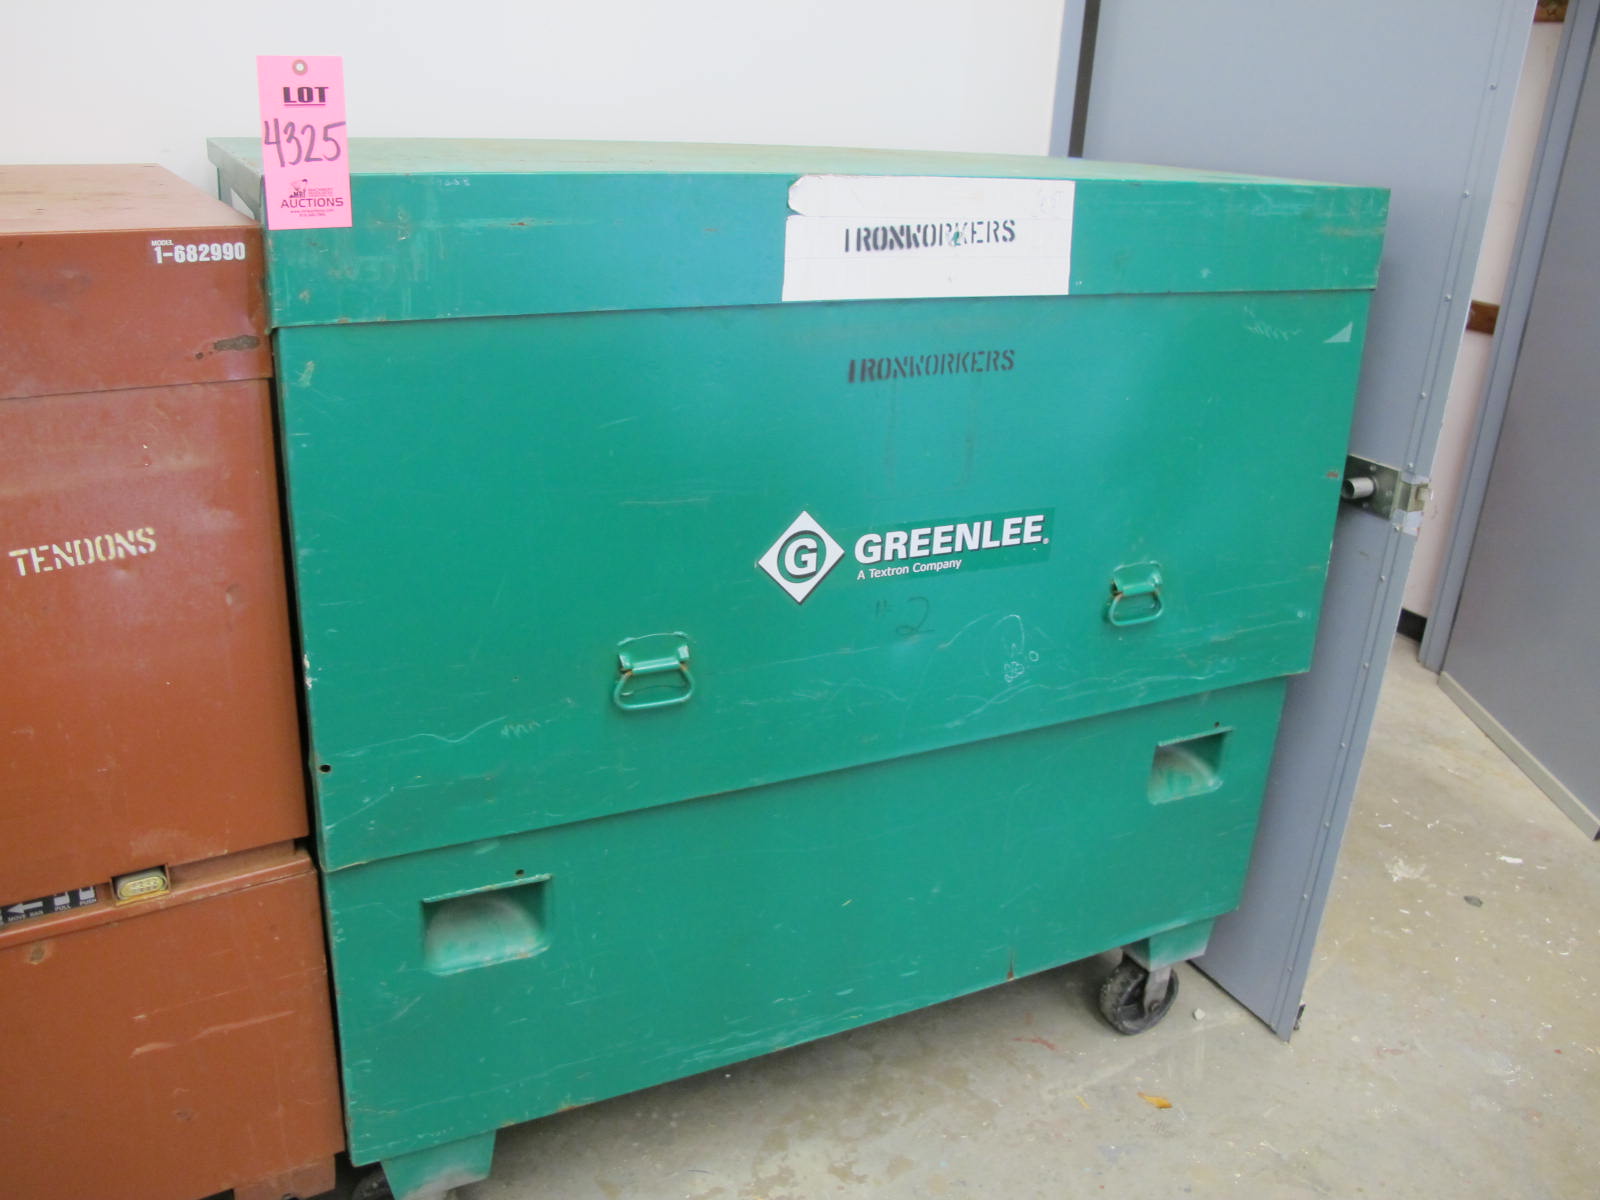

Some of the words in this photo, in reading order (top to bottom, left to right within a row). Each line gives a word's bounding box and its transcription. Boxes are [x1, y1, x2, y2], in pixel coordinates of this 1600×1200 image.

[283, 86, 329, 104] LOT
[264, 118, 346, 167] 4325
[280, 197, 344, 209] AUCTIONS
[154, 242, 246, 264] 1-682990
[844, 219, 1016, 253] IRONWORKERS
[847, 350, 1015, 384] IRONWORKERS
[8, 527, 157, 577] TENDONS
[784, 538, 818, 578] G
[857, 570, 866, 581] A
[869, 566, 910, 579] Textron
[912, 559, 963, 573] Company
